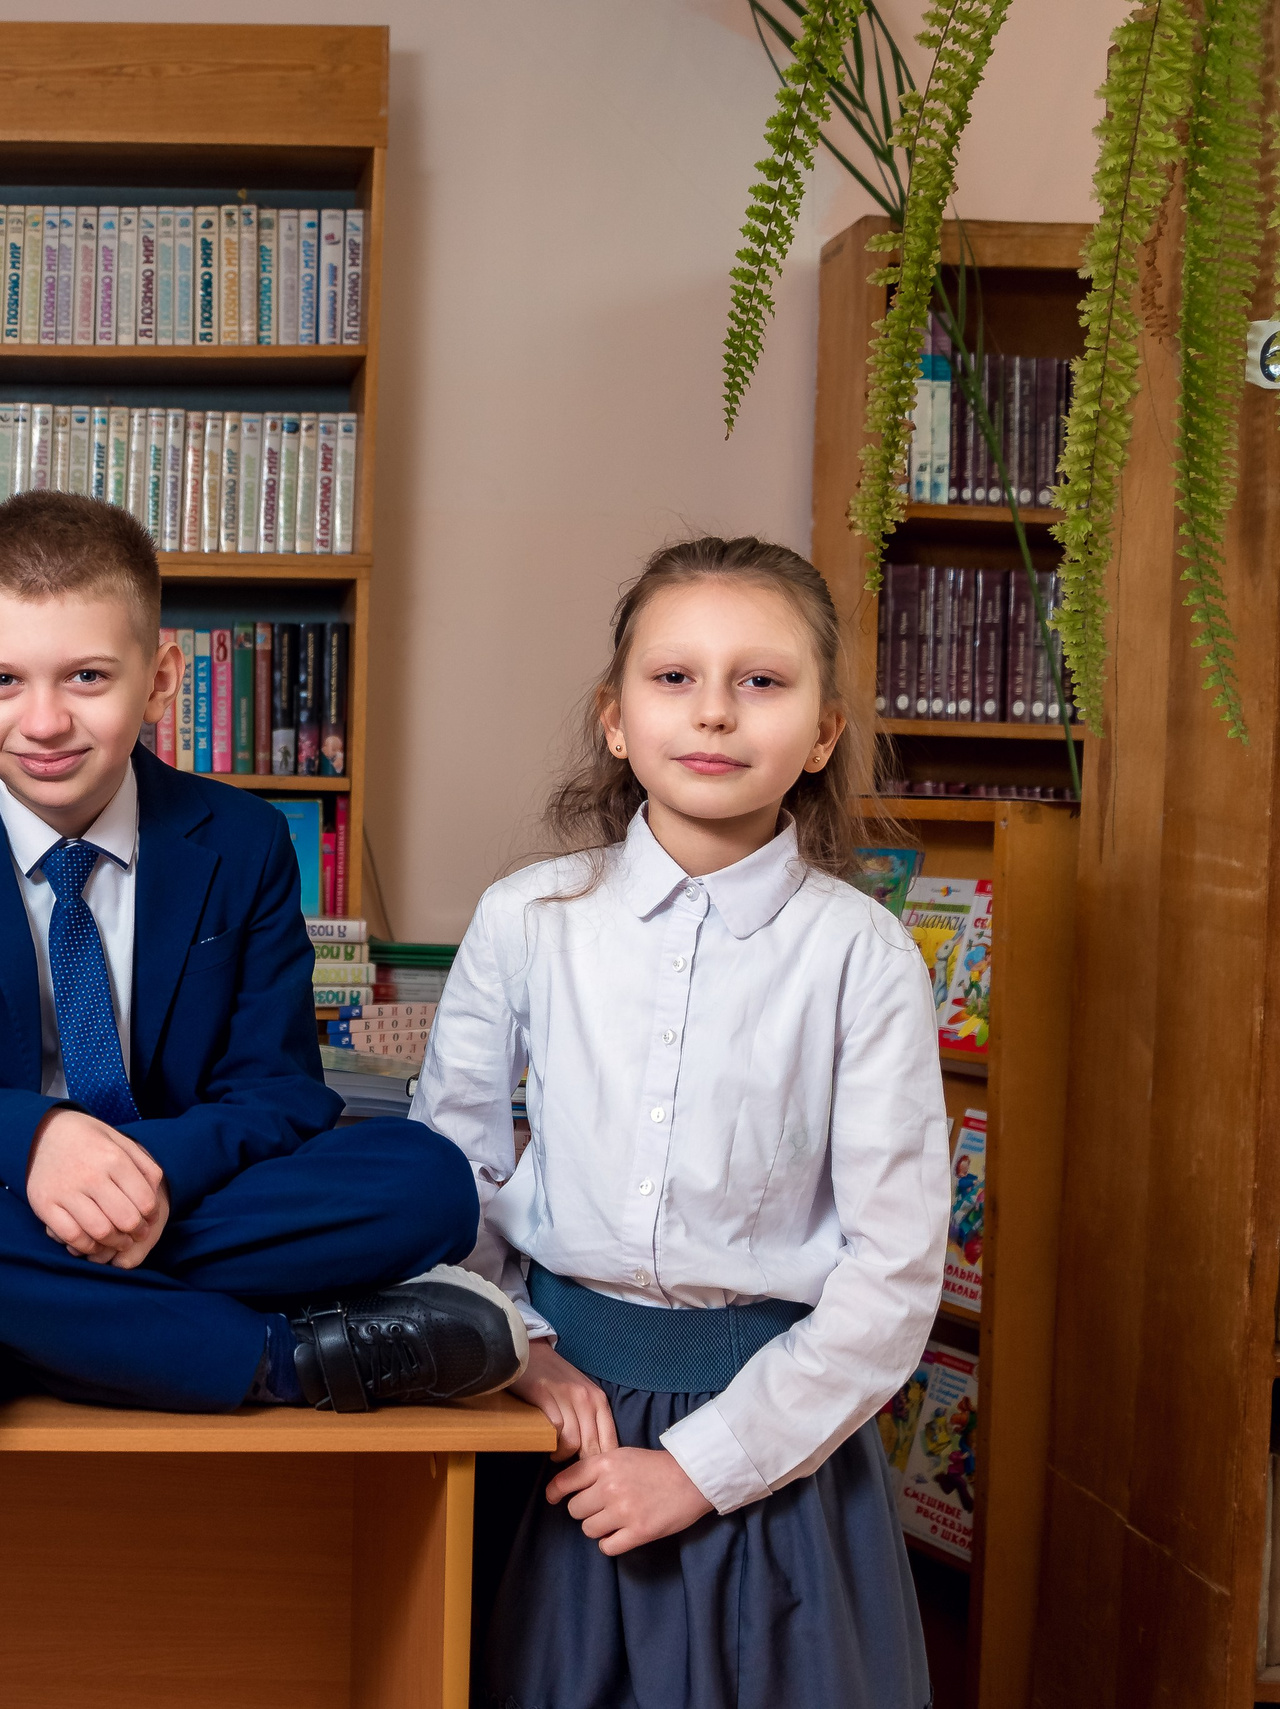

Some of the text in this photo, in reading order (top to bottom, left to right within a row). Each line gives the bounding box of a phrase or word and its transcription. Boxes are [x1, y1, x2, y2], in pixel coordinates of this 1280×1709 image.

[182, 633, 191, 656] 6
[216, 632, 227, 663] 8
[307, 925, 347, 937] Я ПОЗ
[315, 945, 355, 960] Я ПОЗ
[314, 990, 361, 1005] Я ПОЗ
[377, 1006, 437, 1016] БИОЛ
[364, 1019, 427, 1031] БИОЛО
[366, 1031, 427, 1044] БИОЛО
[369, 1044, 426, 1055] БИОЛ
[904, 1486, 962, 1520] СМЕШНЫЕ
[941, 1528, 972, 1550] ШКОЛ
